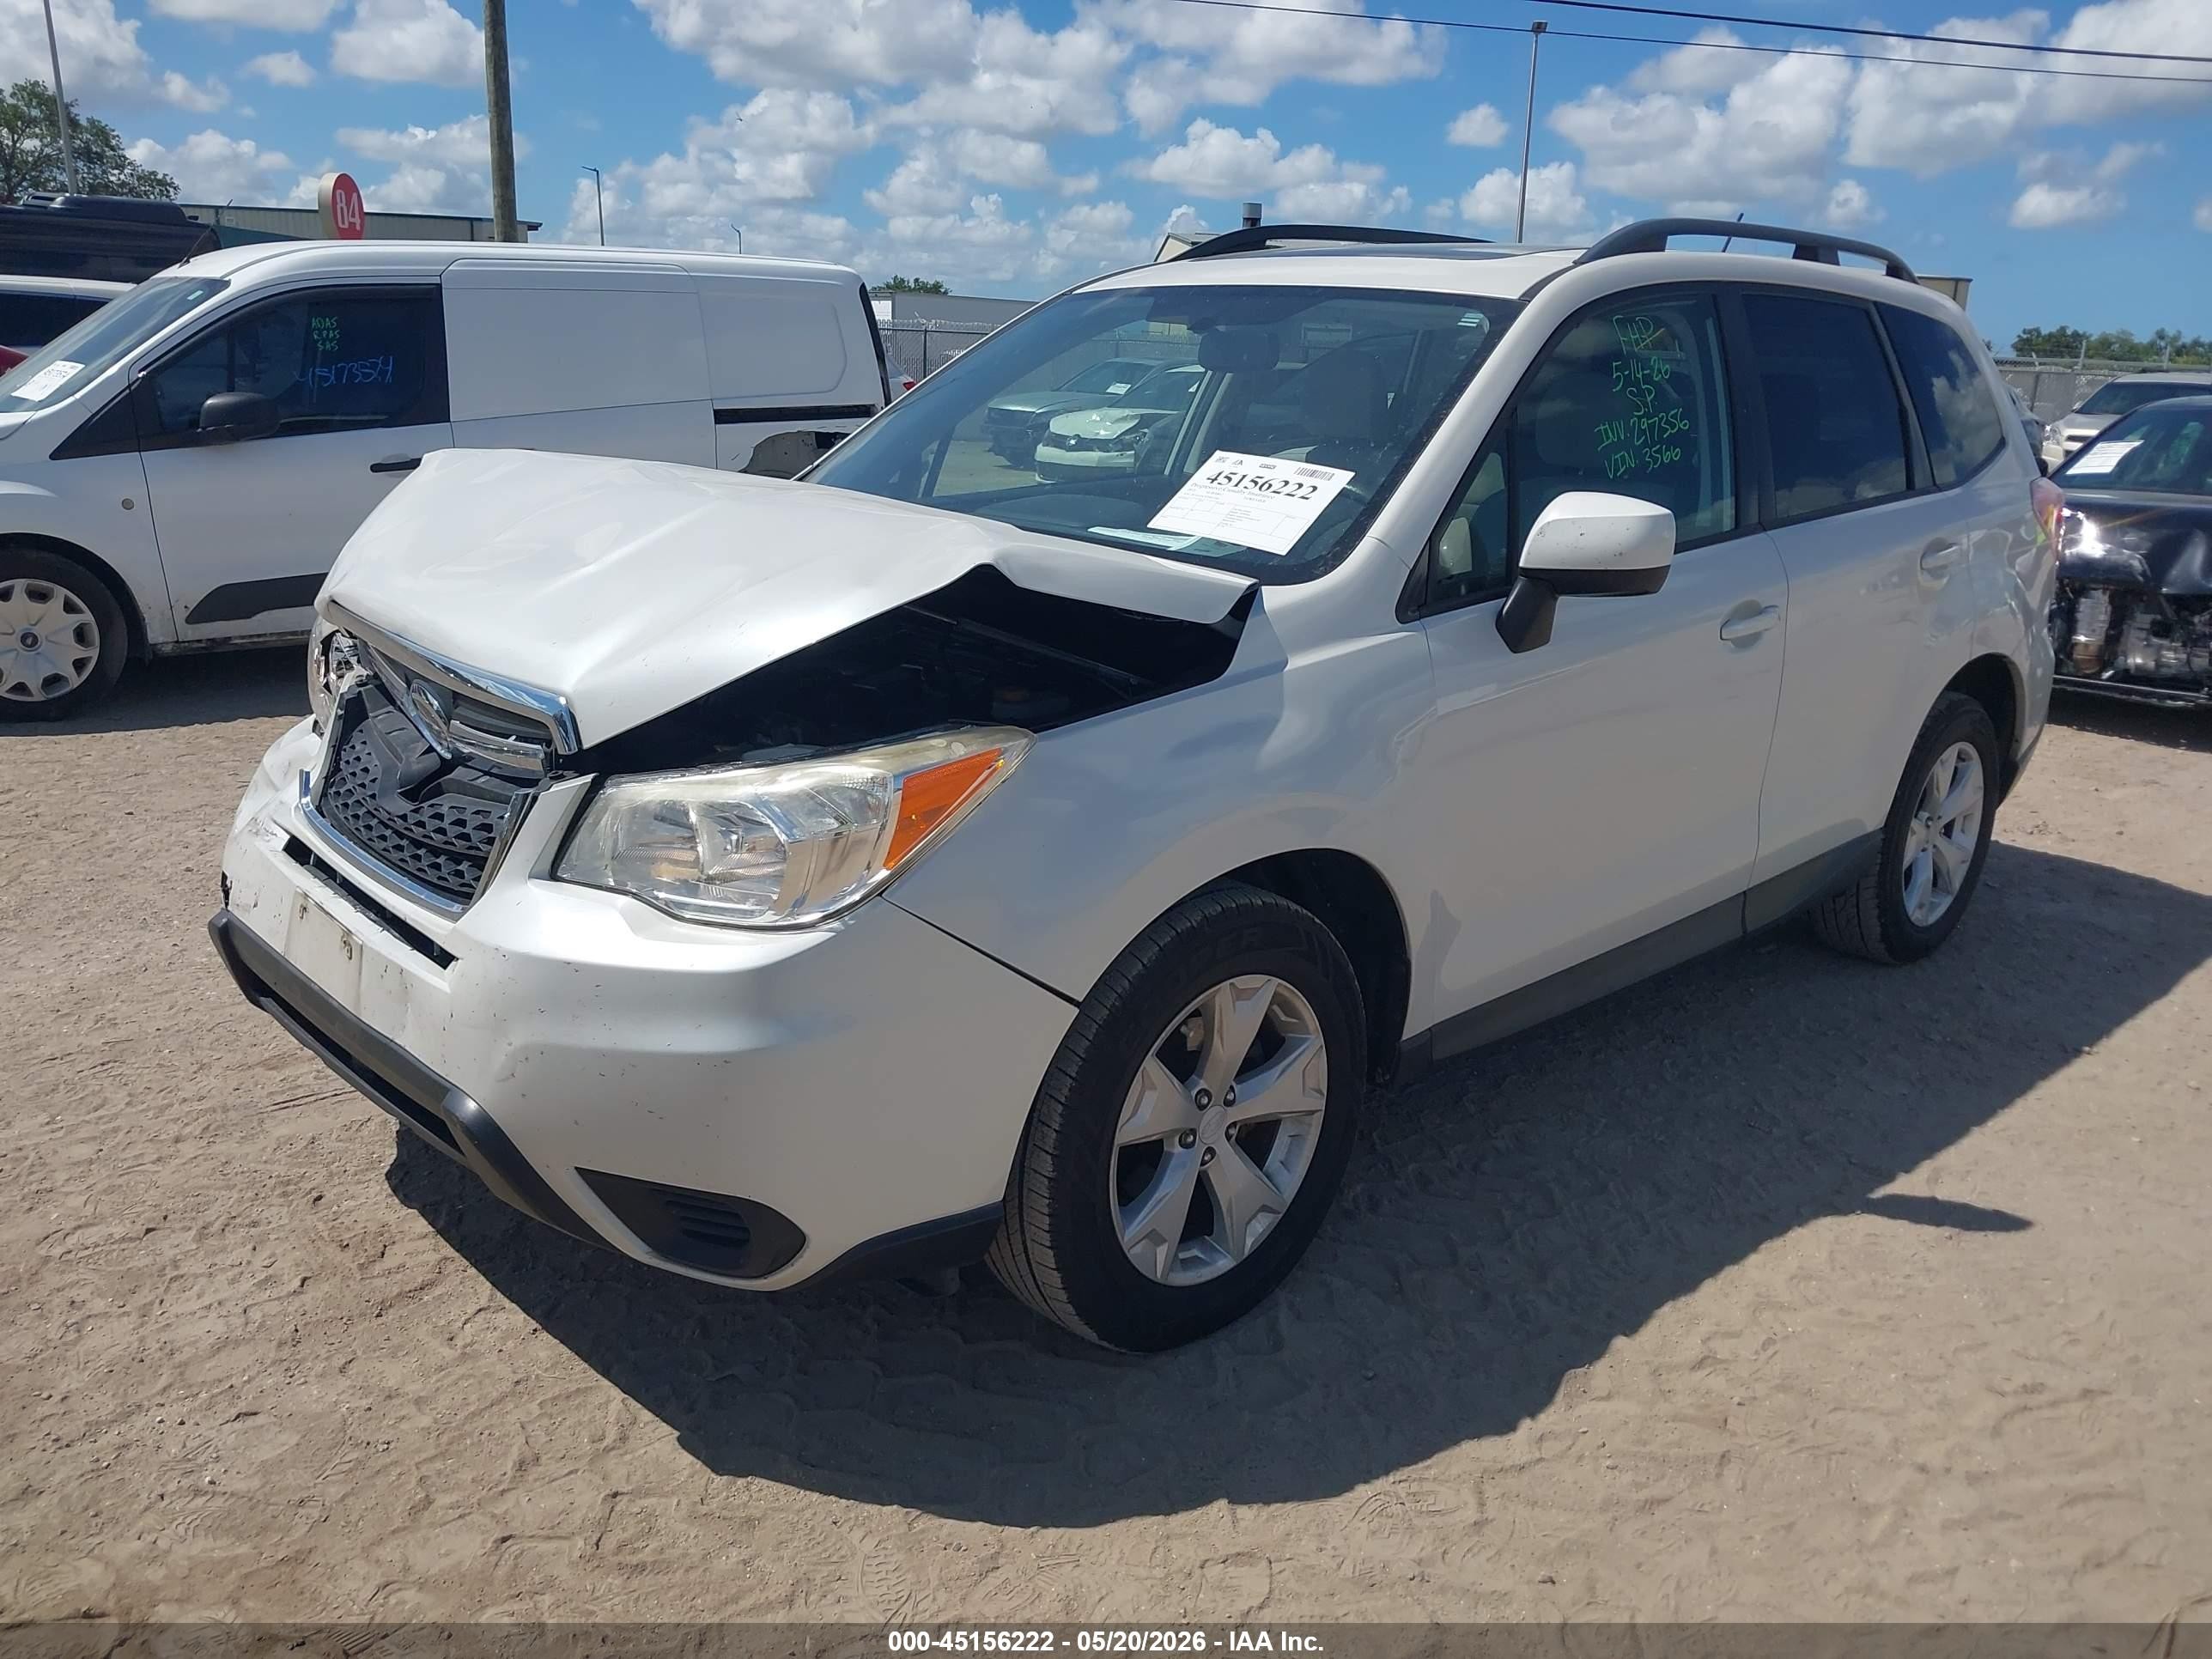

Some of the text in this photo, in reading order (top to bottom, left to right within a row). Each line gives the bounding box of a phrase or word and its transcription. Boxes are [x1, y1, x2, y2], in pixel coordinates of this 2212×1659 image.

[336, 189, 361, 232] 84
[1613, 356, 1670, 392] 5-14-26
[1631, 408, 1690, 446] 297356
[1643, 445, 1681, 473] 3566
[1206, 470, 1319, 501] 45156222
